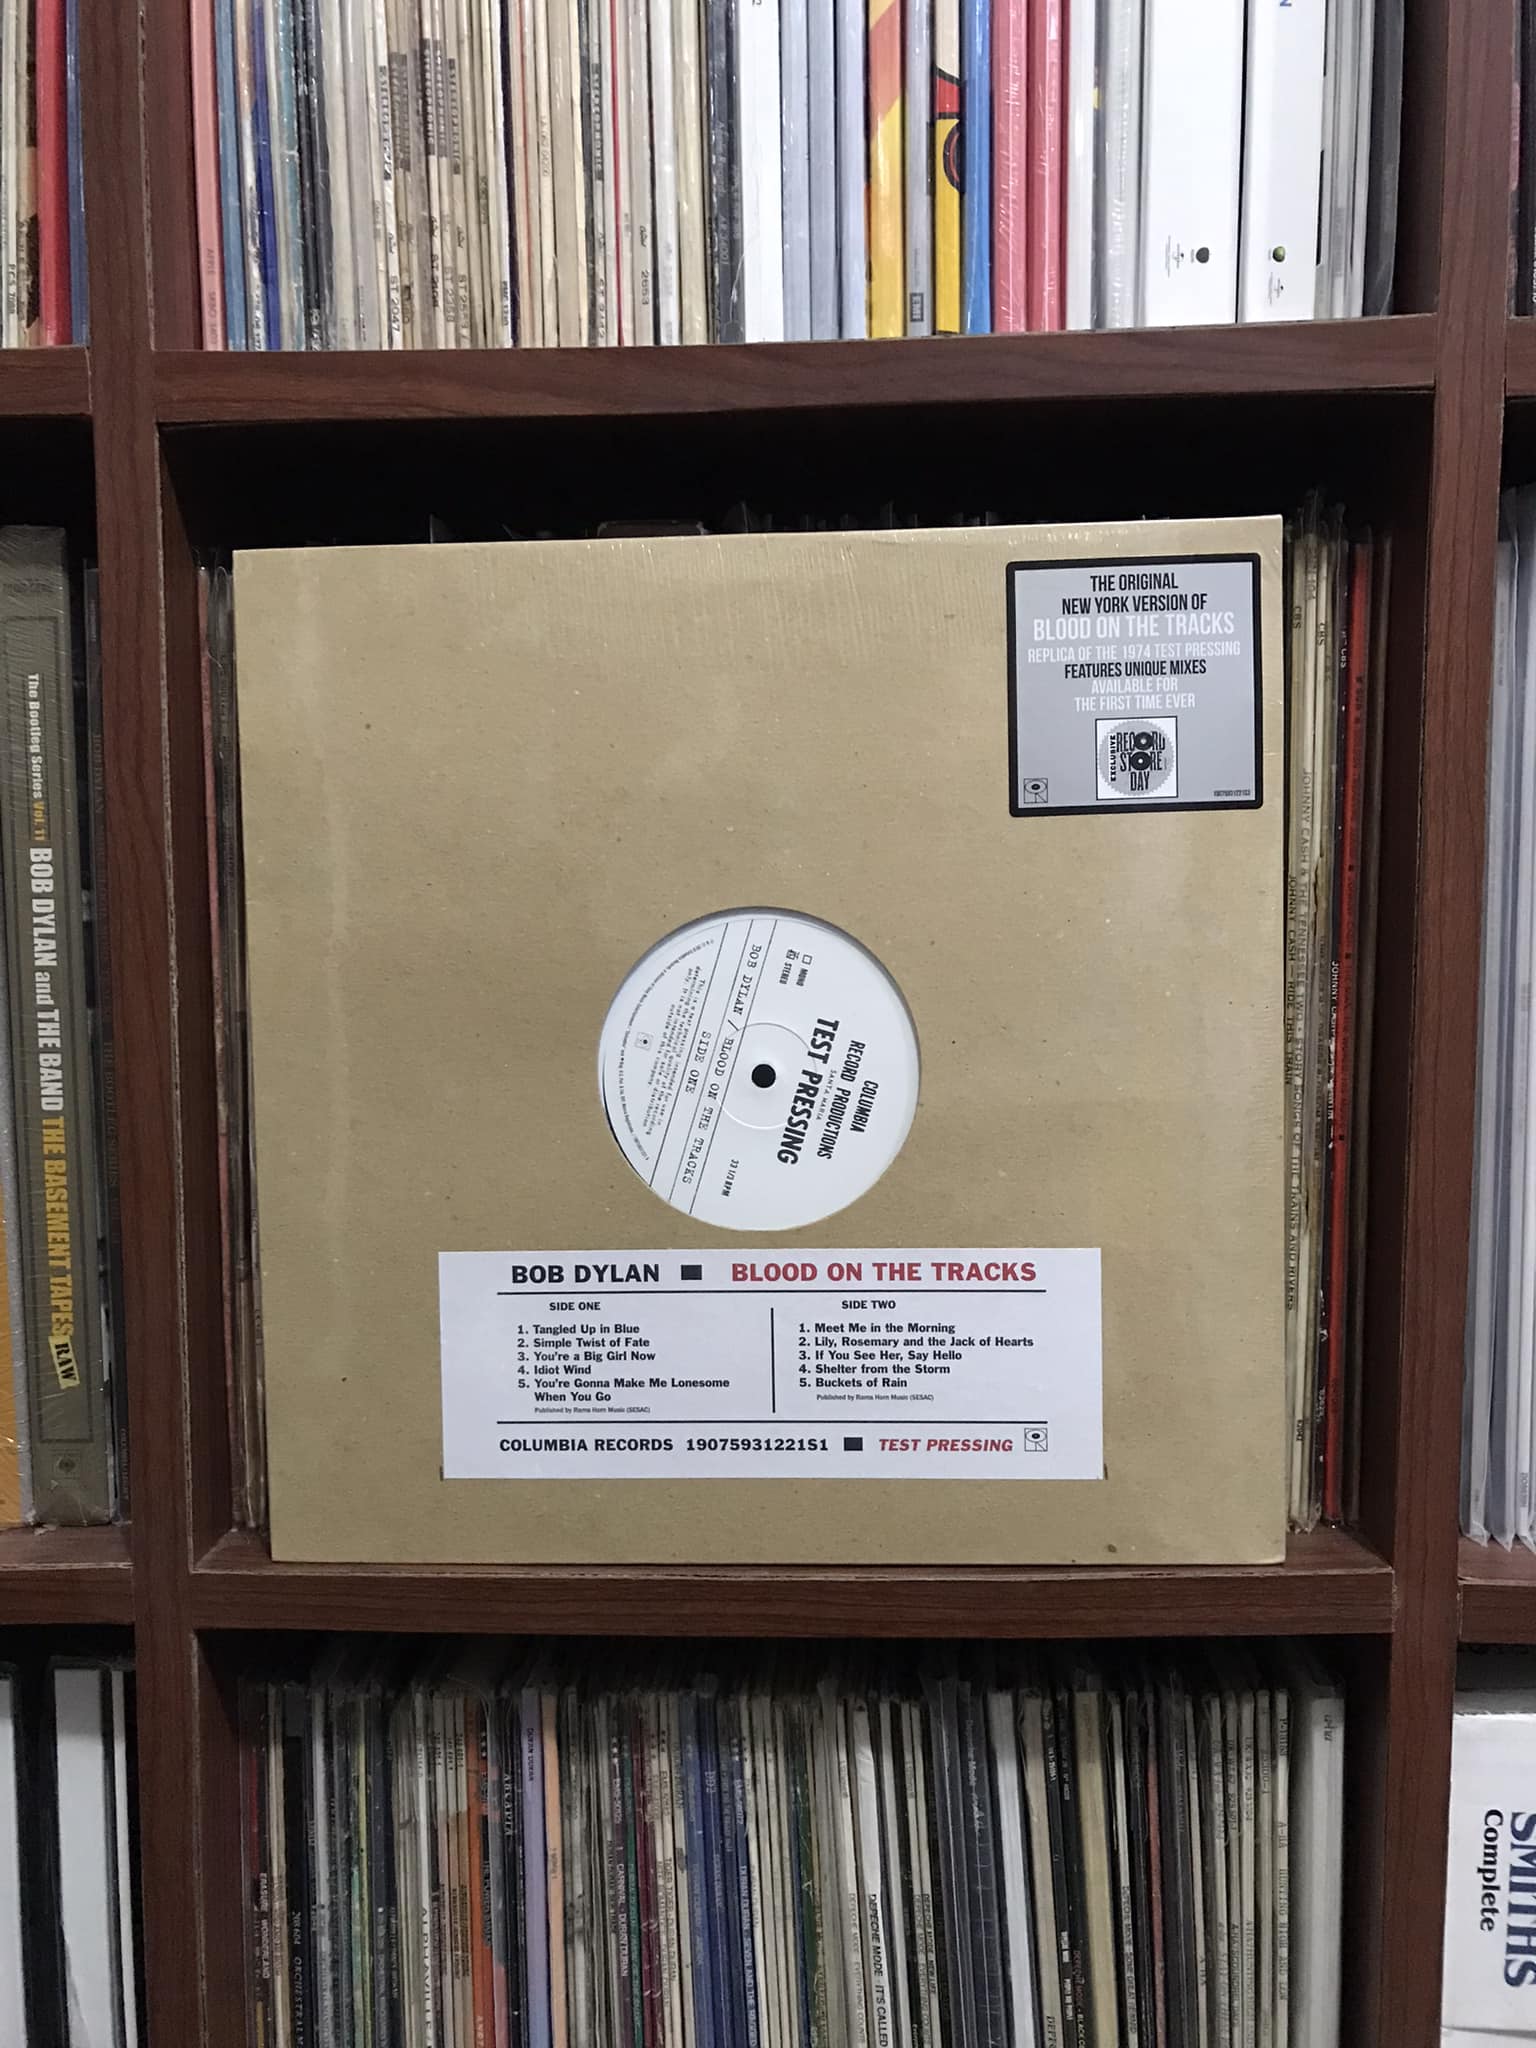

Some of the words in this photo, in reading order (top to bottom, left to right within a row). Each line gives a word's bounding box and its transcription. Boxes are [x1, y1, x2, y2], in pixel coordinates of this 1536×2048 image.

[912, 295, 921, 319] EMI
[1090, 575, 1115, 592] THE
[1119, 573, 1178, 590] ORIGINAL
[1062, 598, 1091, 615] NEW
[1094, 597, 1128, 613] YORK
[1133, 595, 1187, 612] VERSION
[1192, 593, 1207, 610] OF
[1034, 618, 1091, 641] BLOOD
[1096, 617, 1120, 639] ON
[1126, 615, 1159, 637] THE
[1166, 612, 1234, 636] TRACKS
[1293, 605, 1302, 630] CBS
[1028, 647, 1075, 662] REPLICA
[1079, 647, 1092, 661] OF
[1096, 645, 1117, 660] THE
[1122, 644, 1150, 659] 1974
[1155, 643, 1181, 658] TEST
[1185, 641, 1240, 656] PRESSING
[1065, 663, 1122, 678] FEATURES
[1125, 661, 1167, 677] UNIQUE
[1170, 659, 1206, 674] MIXES
[27, 674, 41, 698] The
[1091, 678, 1152, 694] AVAILABLE
[1156, 678, 1178, 692] FOR
[1075, 697, 1096, 712] THE
[1100, 696, 1131, 711] FIRST
[1135, 695, 1162, 709] TIME
[1166, 693, 1195, 708] EVER
[29, 701, 42, 753] Bootleg
[1116, 731, 1165, 751] RECORD
[1120, 751, 1162, 771] STORE
[32, 756, 44, 798] Series
[1130, 771, 1150, 791] DAY
[33, 801, 45, 826] Vol.
[34, 828, 45, 840] 11
[30, 847, 53, 893] BOB
[1287, 876, 1297, 922] JOHNNY
[32, 898, 57, 966] DYLAN
[745, 942, 762, 969] BOB
[1287, 930, 1296, 962] CASH
[778, 961, 792, 985] STEREO
[34, 972, 55, 1004] and
[731, 973, 753, 1015] DYLAN
[1286, 981, 1296, 1009] RIDE
[37, 1009, 61, 1048] THE
[806, 1015, 839, 1064] TEST
[1286, 1016, 1295, 1043] THIS
[693, 1030, 712, 1063] SIDE
[713, 1036, 733, 1077] BLOOD
[839, 1039, 865, 1082] RECORD
[1284, 1051, 1294, 1086] TRAIN
[39, 1053, 63, 1111] BAND
[683, 1068, 700, 1095] ONE
[706, 1082, 720, 1099] ON
[823, 1069, 836, 1094] SANTA
[697, 1105, 713, 1130] THE
[775, 1068, 822, 1166] PRESSING
[815, 1096, 827, 1121] MARIA
[848, 1079, 878, 1134] COLUMBIA
[43, 1116, 65, 1154] THE
[815, 1086, 850, 1160] PRODUCTIONS
[681, 1137, 703, 1184] TRACKS
[44, 1160, 71, 1269] BASEMENT
[511, 1265, 565, 1283] BOB
[574, 1264, 660, 1283] DYLAN
[732, 1263, 818, 1281] BLOOD
[827, 1263, 863, 1281] ON
[872, 1263, 922, 1281] THE
[931, 1262, 1037, 1281] TRACKS
[48, 1274, 74, 1337] TAPES
[549, 1301, 575, 1311] SIDE
[578, 1301, 601, 1311] ONE
[841, 1300, 868, 1310] SIDE
[871, 1300, 896, 1310] TWO
[517, 1324, 528, 1335] 1.
[532, 1324, 577, 1335] Tangled
[580, 1324, 597, 1335] Up
[600, 1324, 610, 1335] in
[614, 1324, 640, 1335] Blue
[799, 1323, 810, 1334] 1.
[814, 1323, 845, 1334] Meet
[848, 1323, 867, 1334] Me
[870, 1323, 881, 1334] in
[885, 1323, 903, 1334] the
[907, 1323, 956, 1334] Morning
[517, 1337, 529, 1348] 2.
[533, 1337, 572, 1348] Simple
[575, 1337, 606, 1348] Twist
[609, 1337, 621, 1348] of
[624, 1337, 650, 1348] Fate
[799, 1337, 811, 1347] 2.
[814, 1337, 838, 1347] Lily,
[841, 1337, 899, 1347] Rosemary
[903, 1337, 924, 1347] and
[927, 1337, 946, 1347] the
[949, 1337, 975, 1347] Jack
[979, 1337, 992, 1347] of
[995, 1337, 1034, 1347] Hearts
[54, 1342, 76, 1380] RAW
[517, 1351, 529, 1362] 3.
[534, 1351, 570, 1362] You're
[573, 1351, 580, 1362] a
[584, 1351, 603, 1362] Big
[606, 1351, 627, 1362] Girl
[630, 1351, 656, 1362] Now
[799, 1350, 811, 1361] 3.
[815, 1350, 825, 1361] If
[828, 1350, 850, 1361] You
[853, 1350, 876, 1361] See
[879, 1350, 903, 1361] Her,
[907, 1350, 929, 1361] Say
[932, 1350, 962, 1361] Hello
[517, 1365, 529, 1375] 4.
[533, 1365, 560, 1375] Idiot
[563, 1365, 592, 1375] Wind
[799, 1364, 811, 1374] 4.
[815, 1364, 857, 1374] Shelter
[861, 1364, 888, 1374] from
[892, 1364, 911, 1374] the
[914, 1364, 951, 1374] Storm
[518, 1378, 530, 1388] 5.
[534, 1378, 570, 1388] You're
[574, 1378, 610, 1388] Gonna
[613, 1378, 646, 1388] Make
[649, 1378, 667, 1388] Me
[671, 1378, 730, 1388] Lonesome
[799, 1377, 811, 1388] 5.
[815, 1377, 863, 1388] Buckets
[866, 1377, 878, 1388] of
[881, 1377, 908, 1388] Rain
[534, 1392, 566, 1402] When
[570, 1392, 592, 1402] You
[595, 1392, 612, 1402] Go
[499, 1439, 588, 1451] COLUMBIA
[594, 1439, 674, 1451] RECORDS
[686, 1438, 828, 1451] 19075931221S1
[879, 1439, 921, 1451] TEST
[926, 1439, 1013, 1451] PRESSING
[1476, 1808, 1505, 1932] Complete
[1503, 1811, 1536, 1988] SMITHS
[868, 1893, 881, 1944] DEPECHE
[872, 1944, 884, 1976] MODE
[875, 1983, 886, 2004] IT'S
[877, 2005, 889, 2047] CALLED
